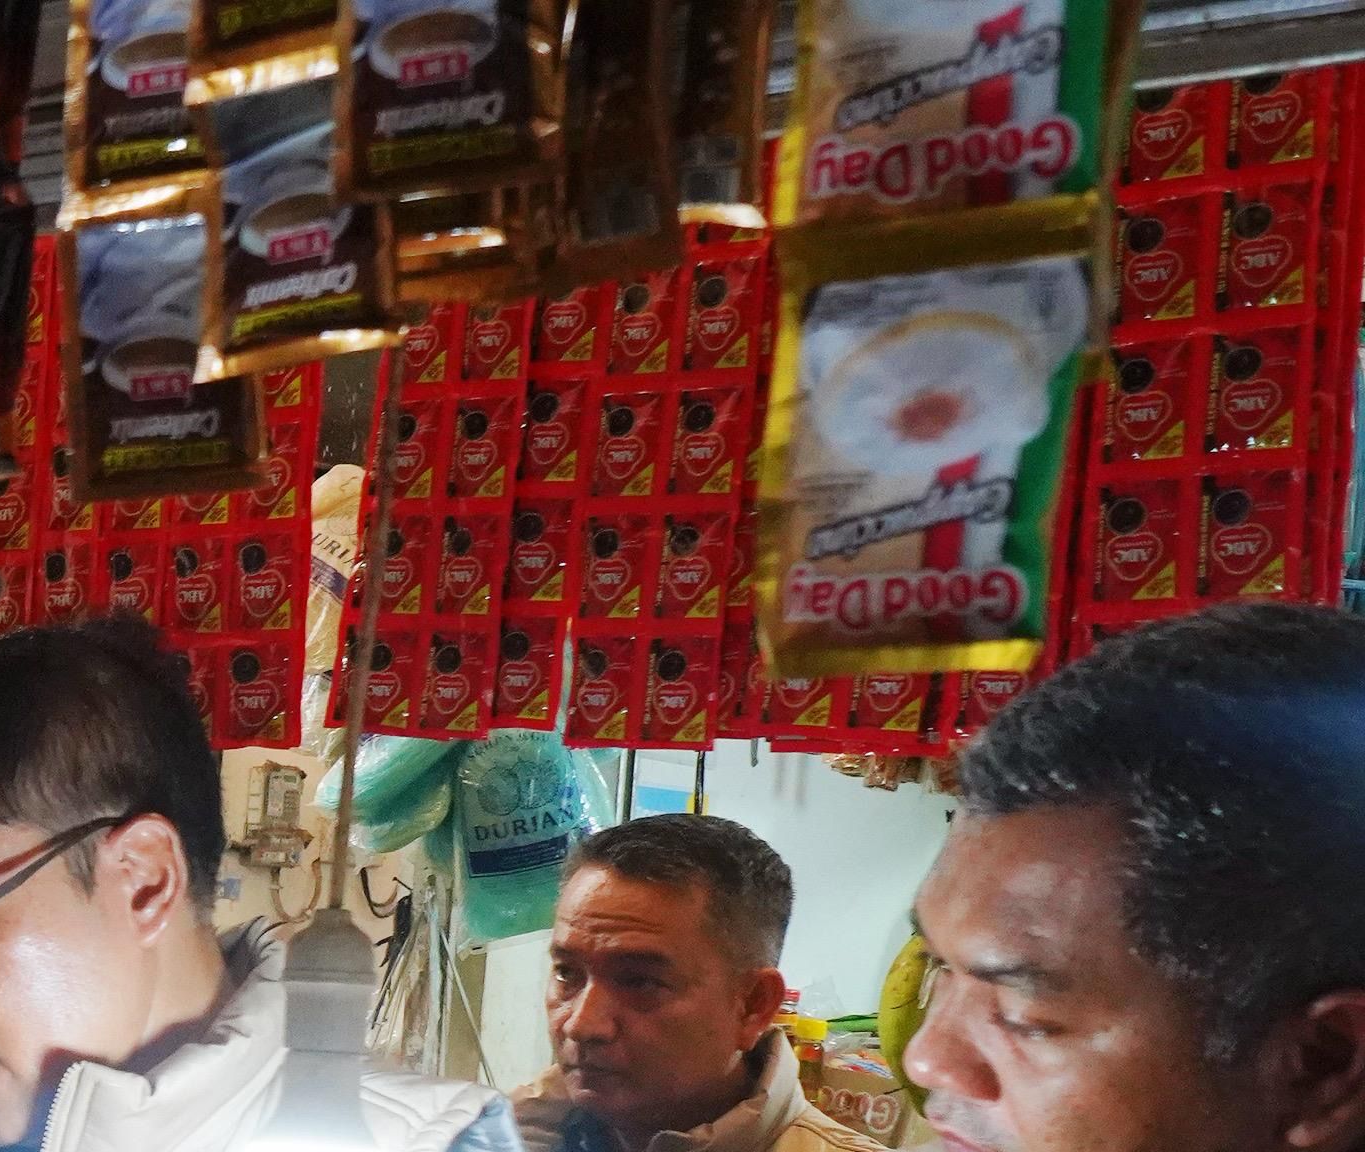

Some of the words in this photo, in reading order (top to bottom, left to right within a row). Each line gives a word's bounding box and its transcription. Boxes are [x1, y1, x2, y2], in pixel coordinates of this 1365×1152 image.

[811, 142, 912, 199] Day
[927, 120, 1073, 193] Good
[882, 569, 1019, 623] Good
[238, 694, 268, 710] ABC
[473, 803, 576, 842] DURIAN
